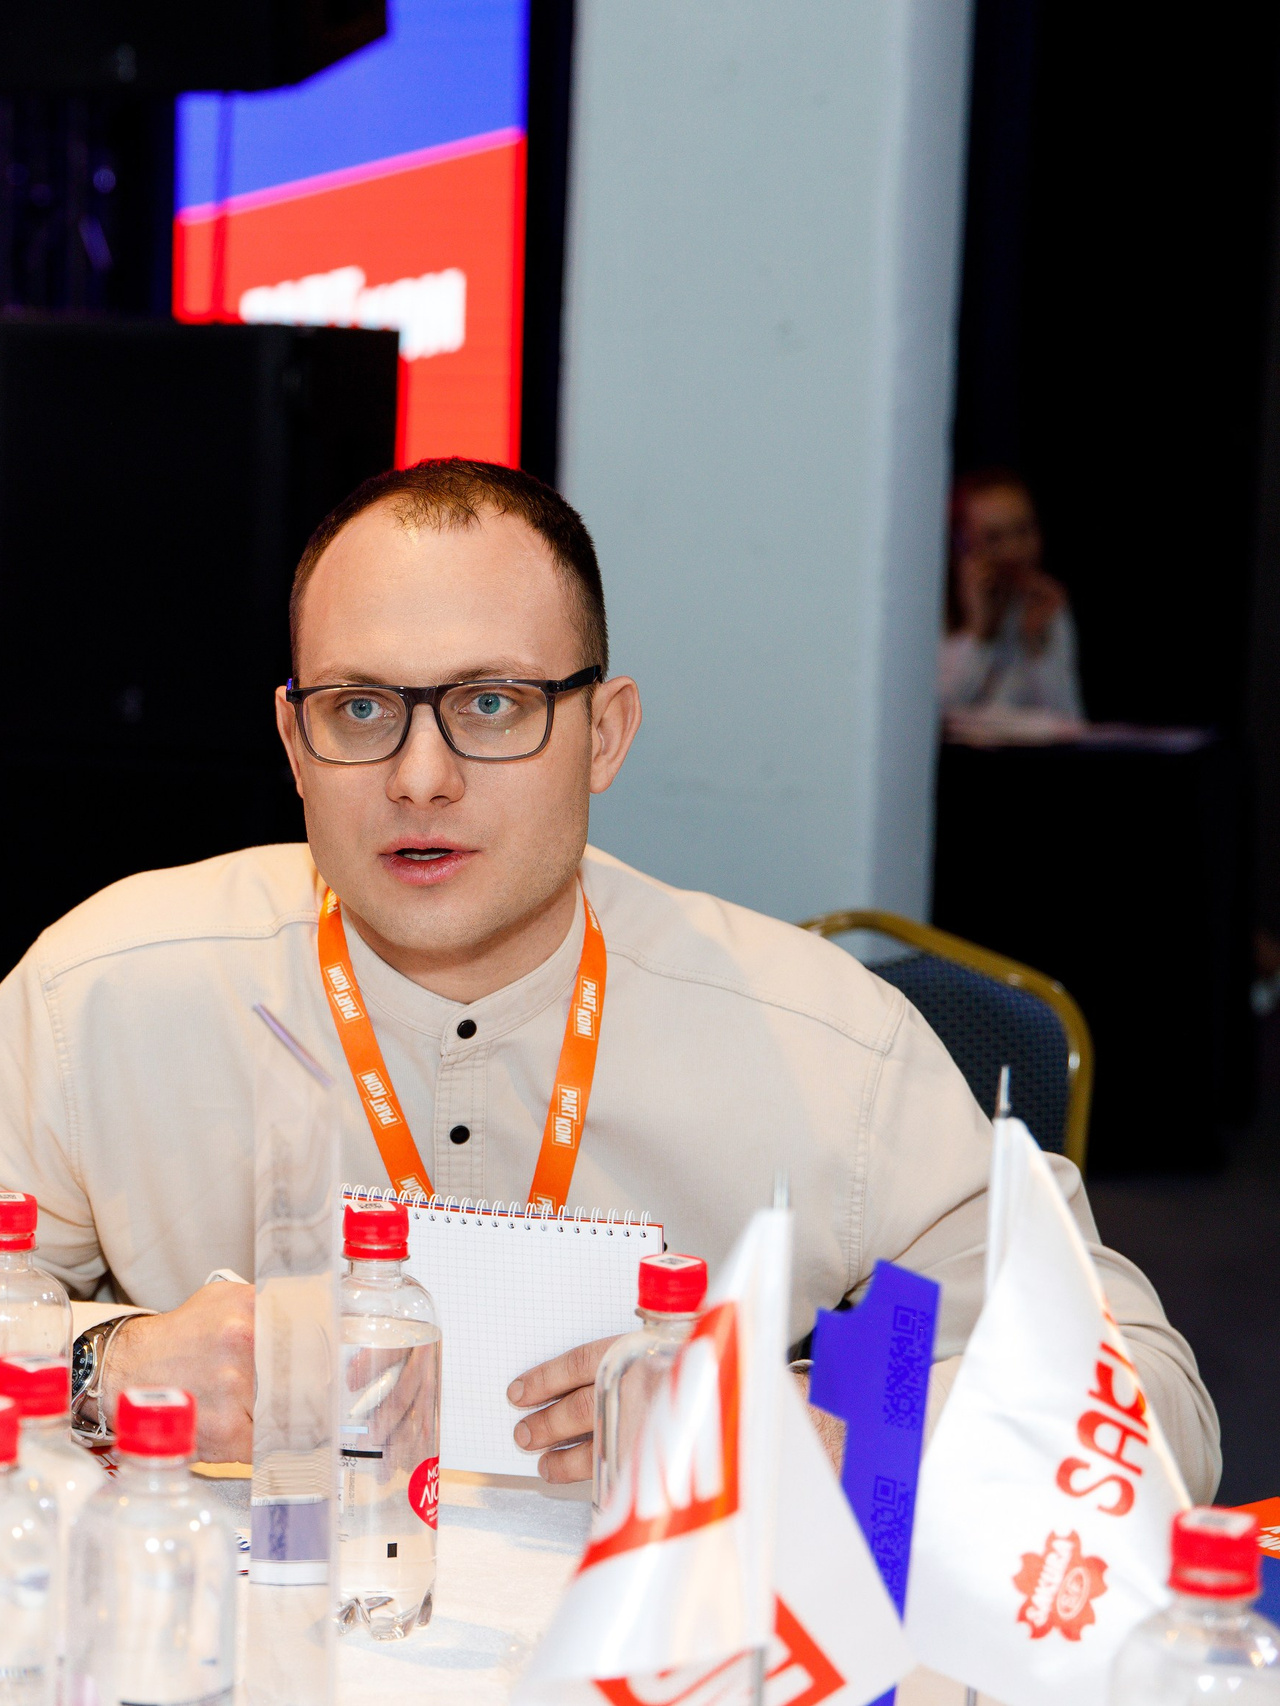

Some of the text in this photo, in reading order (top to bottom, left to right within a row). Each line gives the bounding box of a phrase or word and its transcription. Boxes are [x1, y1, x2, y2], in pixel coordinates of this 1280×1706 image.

[328, 966, 359, 1020] PART KOM
[576, 980, 597, 1036] PART KOM
[362, 1072, 399, 1127] PART KOM
[555, 1087, 578, 1145] PART KOM
[399, 1176, 422, 1199] OM
